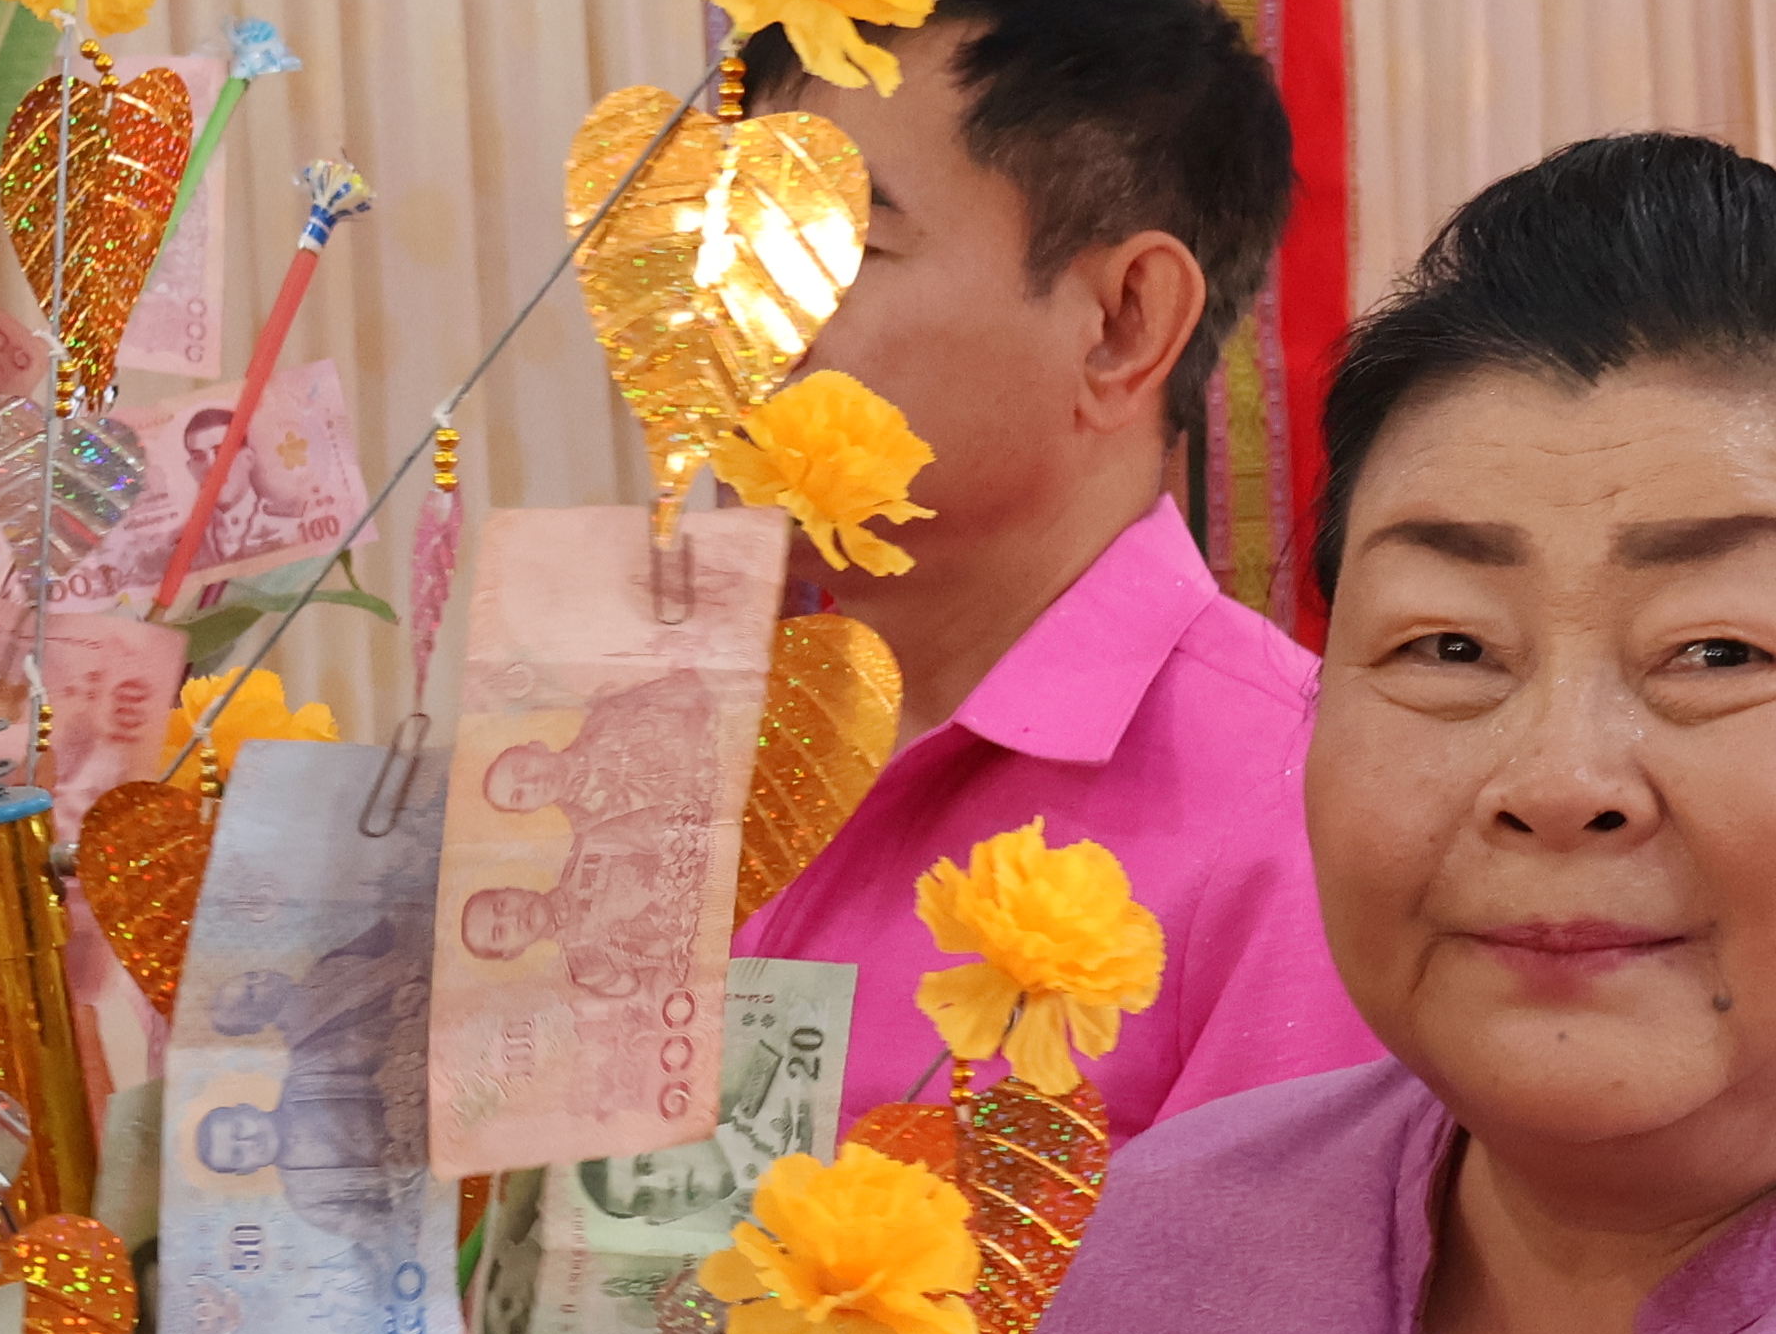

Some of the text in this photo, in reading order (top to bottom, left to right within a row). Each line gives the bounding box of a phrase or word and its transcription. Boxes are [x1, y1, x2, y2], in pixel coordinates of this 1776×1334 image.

[297, 515, 340, 545] 100
[657, 987, 701, 1123] ๑๐๐
[787, 1025, 826, 1082] 20
[228, 1223, 264, 1273] 50
